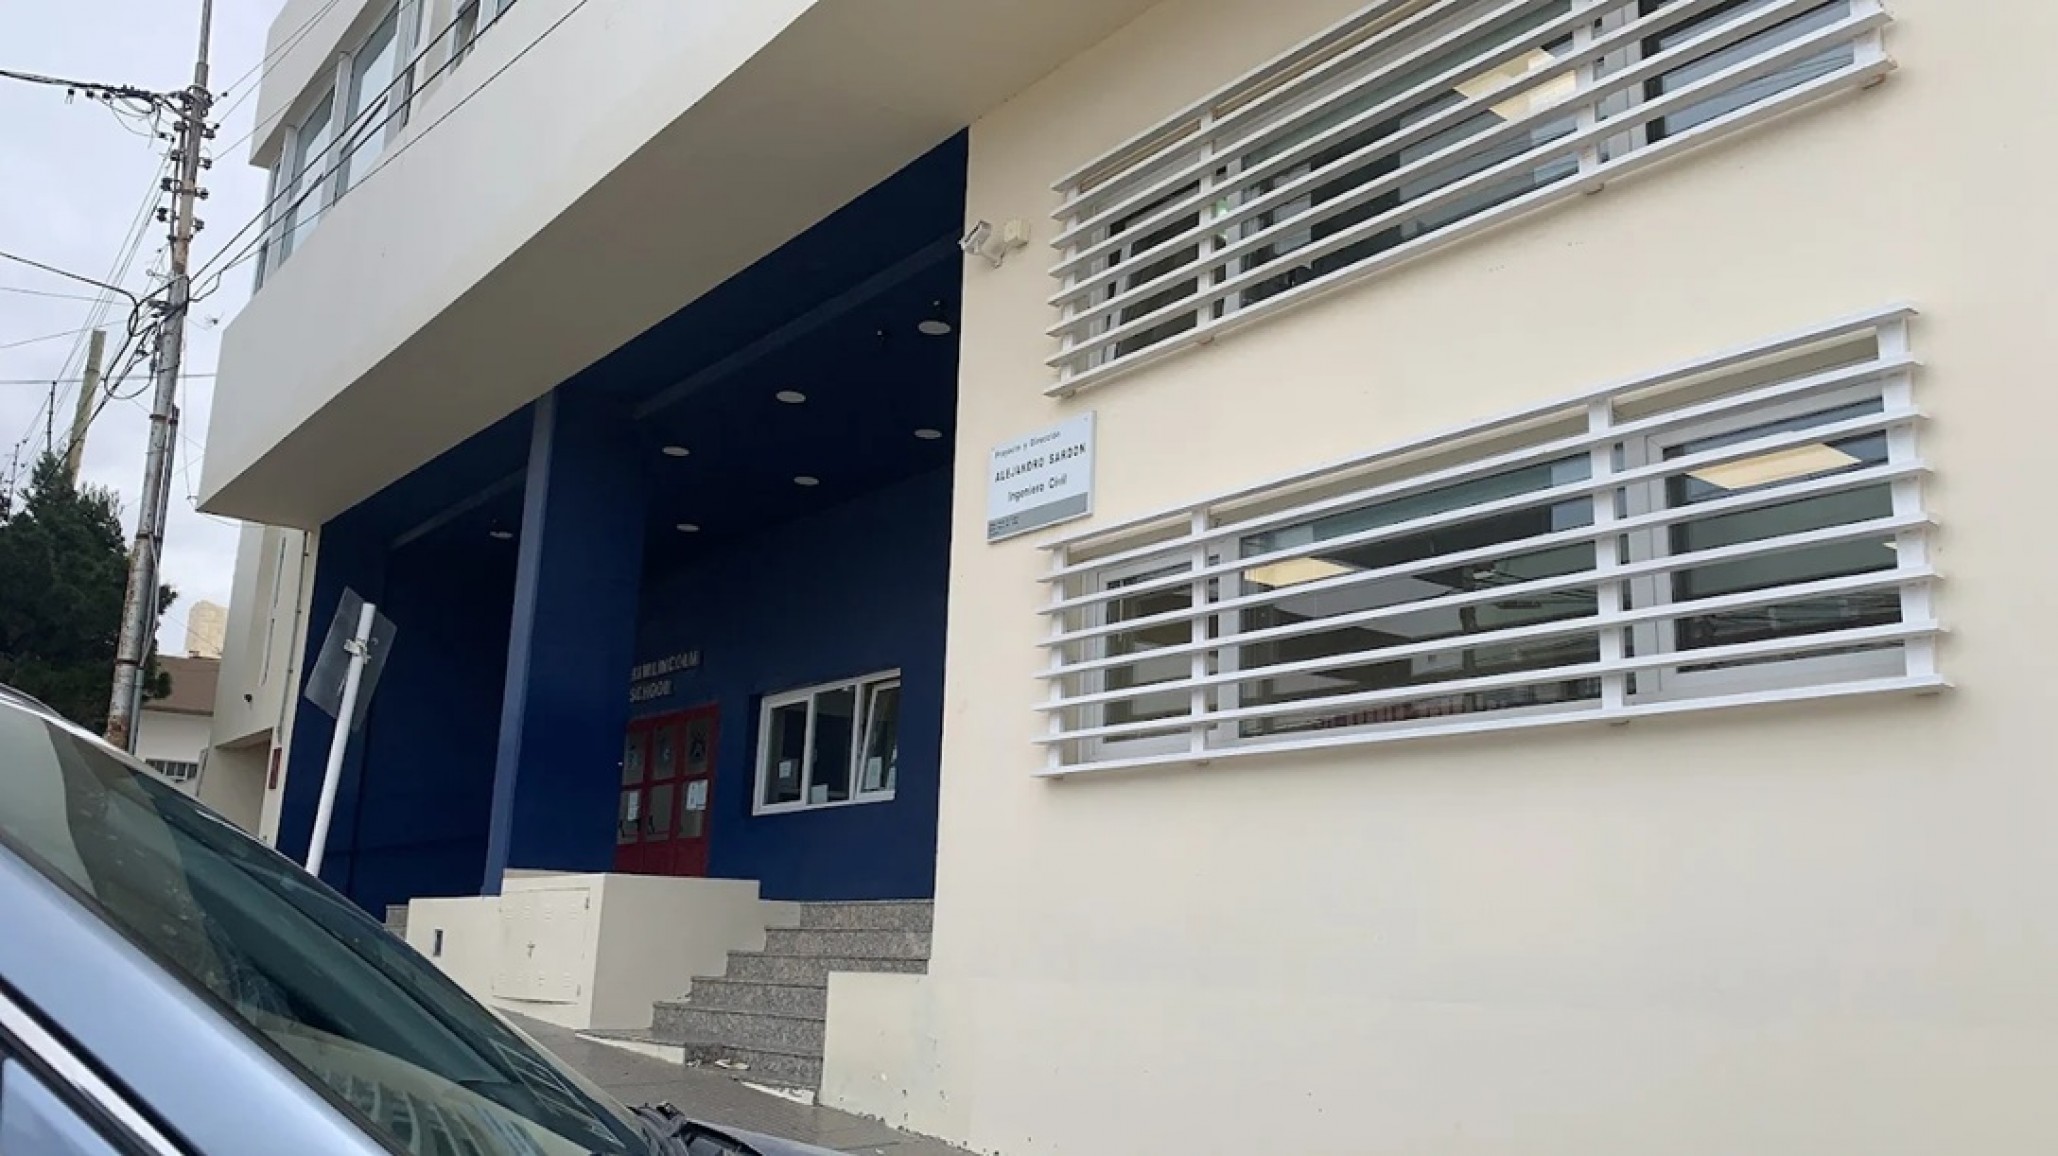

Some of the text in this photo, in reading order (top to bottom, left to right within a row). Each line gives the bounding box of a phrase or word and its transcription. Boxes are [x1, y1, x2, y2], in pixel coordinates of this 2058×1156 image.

[995, 456, 1045, 483] ALEJANDRO
[1008, 472, 1068, 503] Ingeniero Civil
[629, 680, 672, 703] SCHOOL
